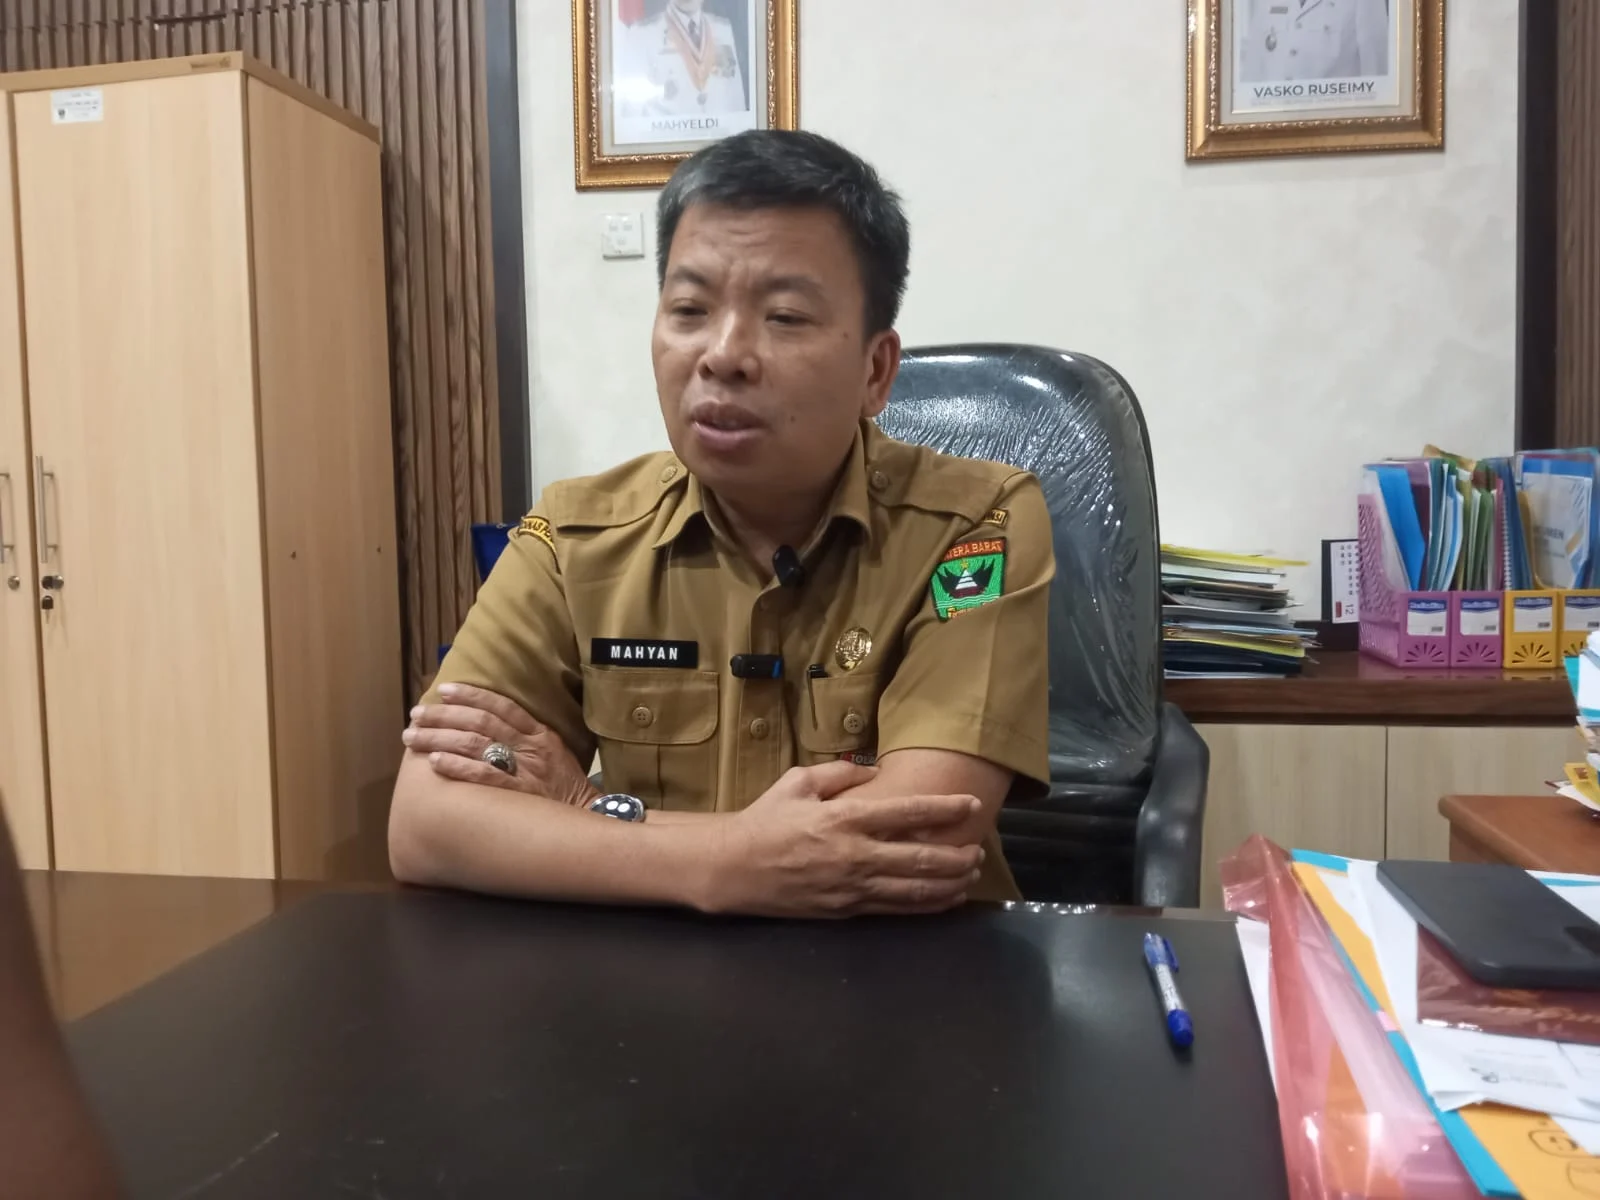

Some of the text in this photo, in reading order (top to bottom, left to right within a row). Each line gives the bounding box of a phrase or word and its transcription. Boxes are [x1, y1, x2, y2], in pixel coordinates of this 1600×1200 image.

[1253, 81, 1375, 99] VASKO RUSEIMY
[650, 118, 720, 132] MAHYELDI
[610, 644, 679, 661] MAHYAN
